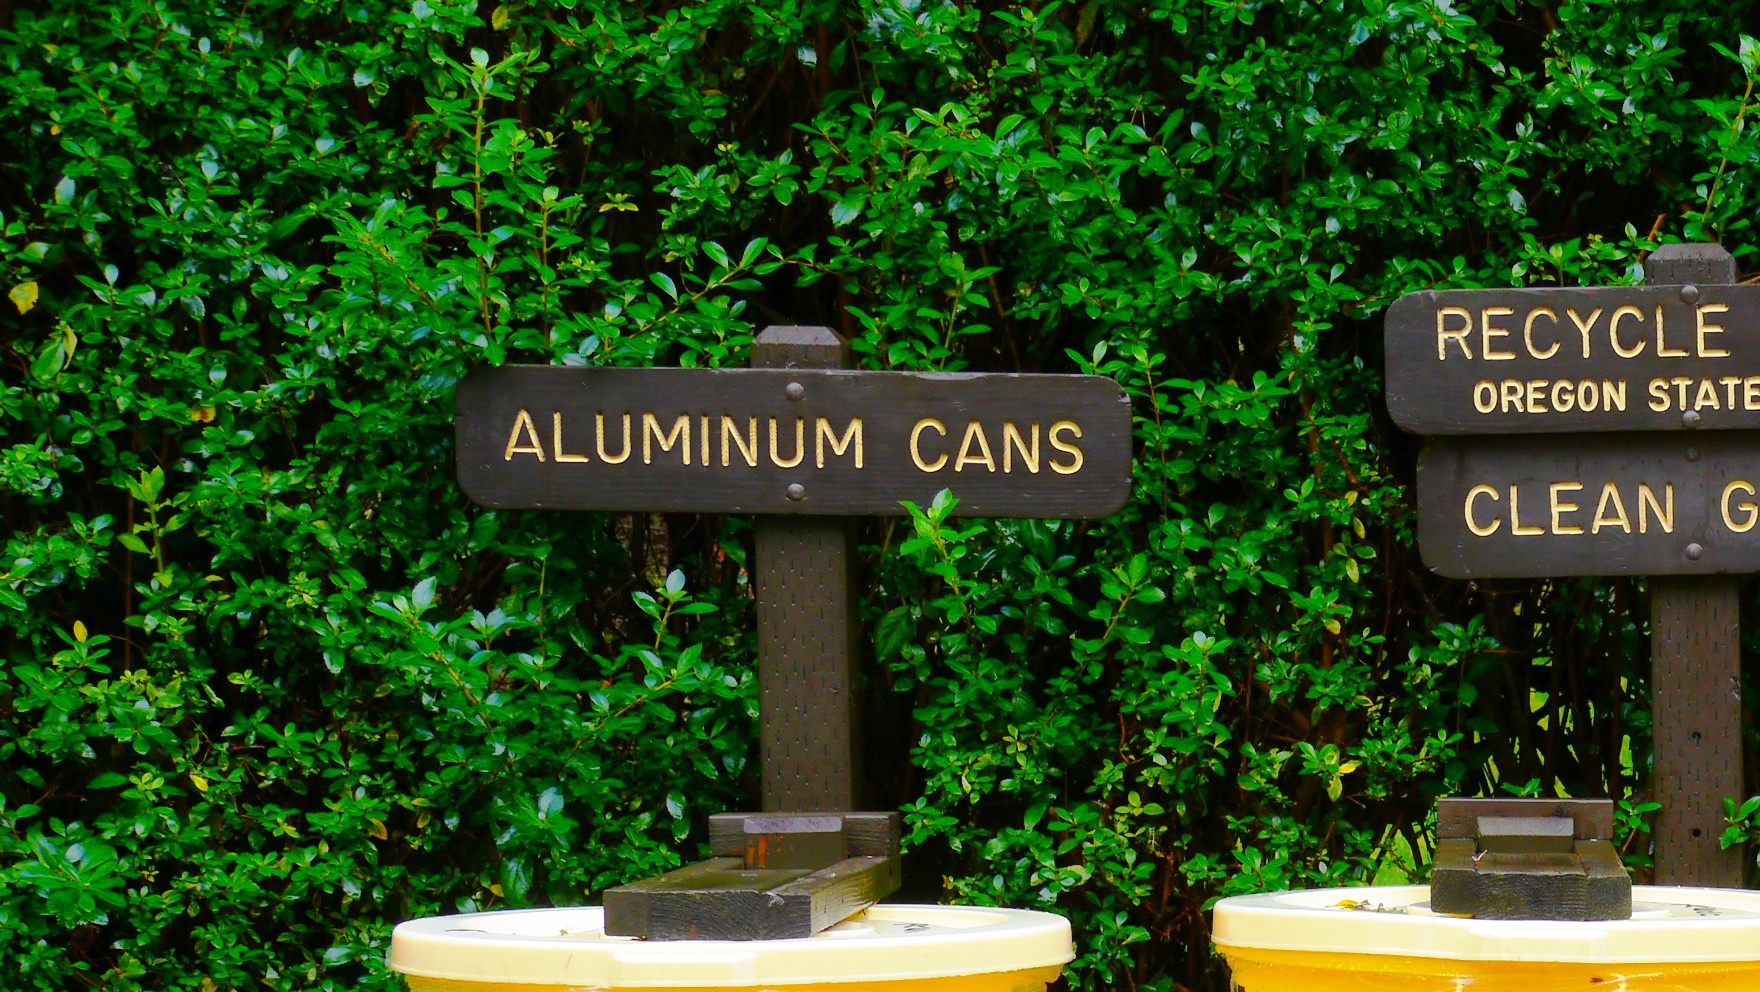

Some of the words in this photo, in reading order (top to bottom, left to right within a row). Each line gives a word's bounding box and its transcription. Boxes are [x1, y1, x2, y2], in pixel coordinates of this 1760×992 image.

[1435, 302, 1732, 361] RECYCLE
[1472, 377, 1628, 414] OREGON
[503, 408, 865, 470] ALUMINUM
[908, 417, 1085, 476] CANS
[1463, 480, 1675, 538] CLEAN
